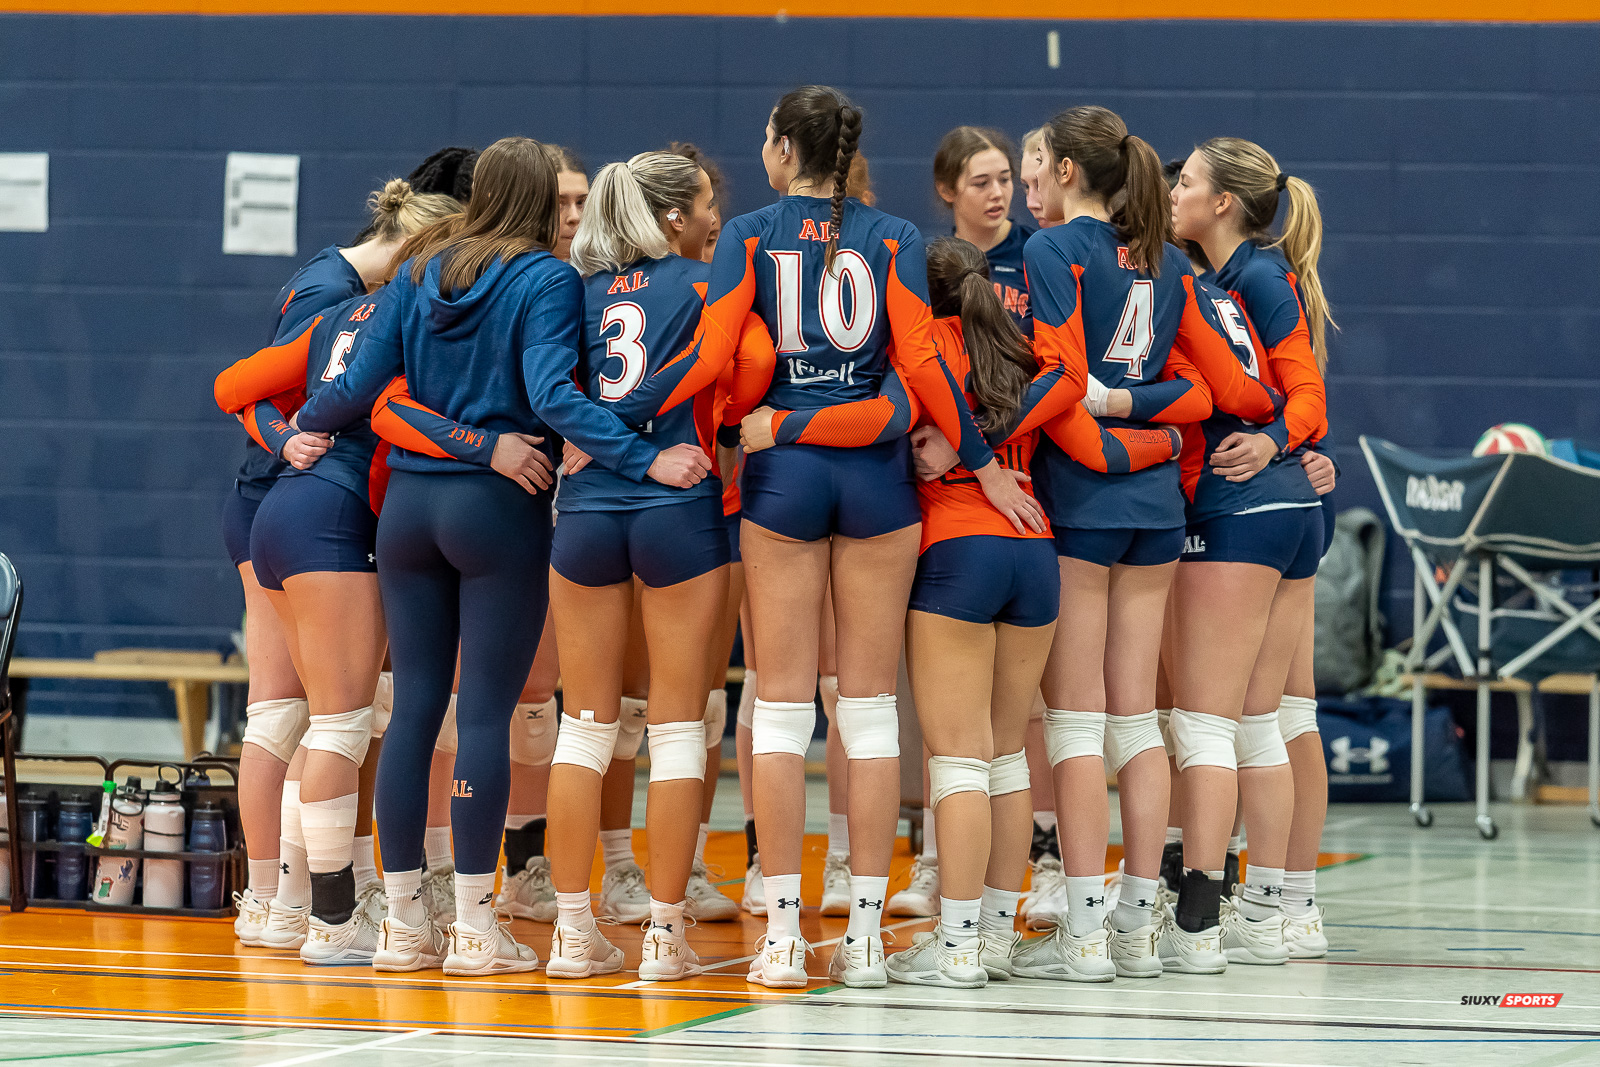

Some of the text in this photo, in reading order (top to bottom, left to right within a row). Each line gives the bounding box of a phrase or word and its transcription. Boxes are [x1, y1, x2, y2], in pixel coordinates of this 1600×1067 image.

[607, 271, 649, 295] AL
[764, 248, 877, 354] 10
[599, 300, 648, 402] 3
[1102, 279, 1155, 380] 4
[1181, 534, 1206, 554] AL
[451, 779, 473, 798] AL
